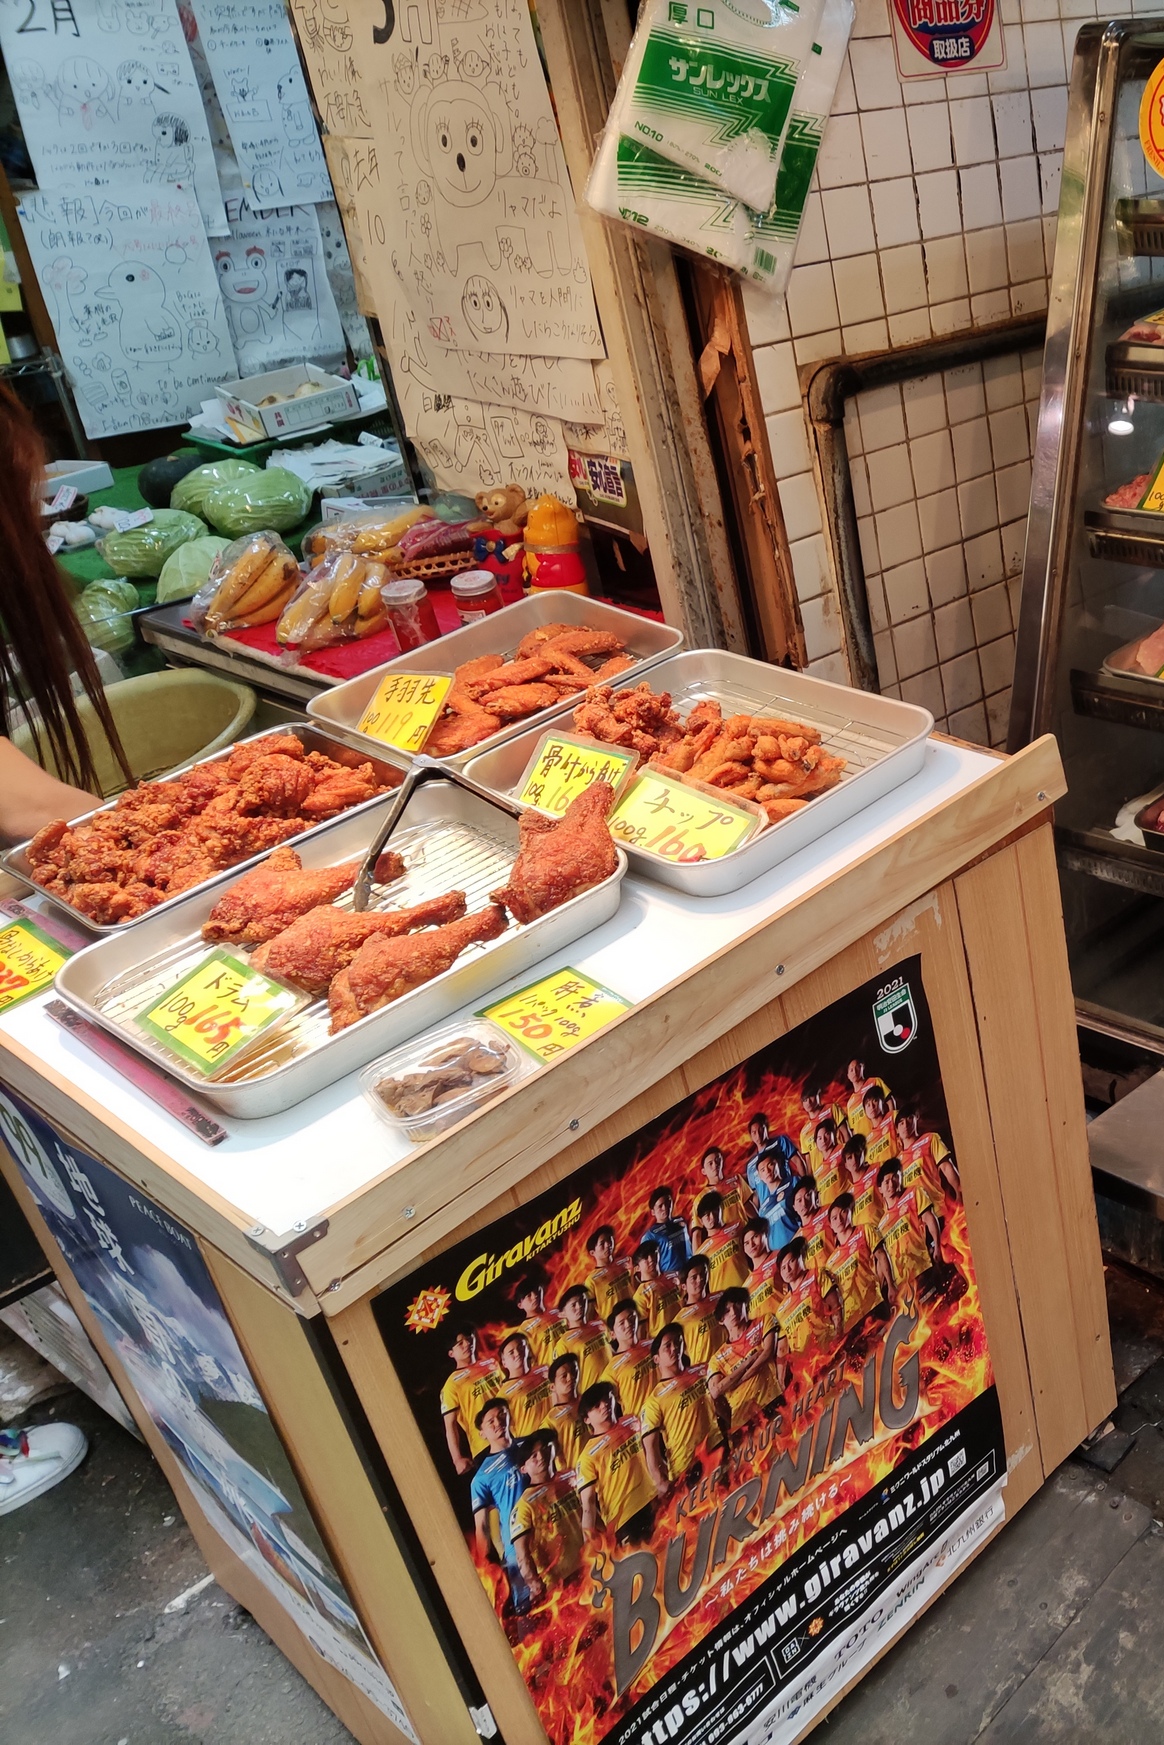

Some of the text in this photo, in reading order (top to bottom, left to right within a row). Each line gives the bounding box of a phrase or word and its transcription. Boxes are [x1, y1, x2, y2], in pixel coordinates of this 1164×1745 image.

[668, 2, 716, 30] 厚口
[932, 37, 971, 59] 取扱店
[669, 56, 772, 104] サンレックス
[693, 86, 744, 106] SUN LEX
[384, 676, 436, 706] 手羽先
[375, 711, 414, 741] 119
[406, 725, 428, 745] 円
[548, 785, 571, 811] 16
[643, 788, 735, 831] チップ
[644, 825, 708, 862] 160
[203, 971, 251, 1013] ドラム
[876, 976, 904, 1001] 2021
[159, 992, 244, 1058] 100g 165 円
[498, 1008, 565, 1057] 150 円
[454, 1196, 583, 1302] Giravanz
[525, 1213, 582, 1262] KITAKYUSHU
[674, 1360, 848, 1524] KEEP YOUR HEART
[596, 1305, 922, 1705] BURNING
[947, 1505, 995, 1559] 北九州銀行
[833, 1608, 885, 1662] TOTO
[762, 1674, 819, 1732] 安川電機
